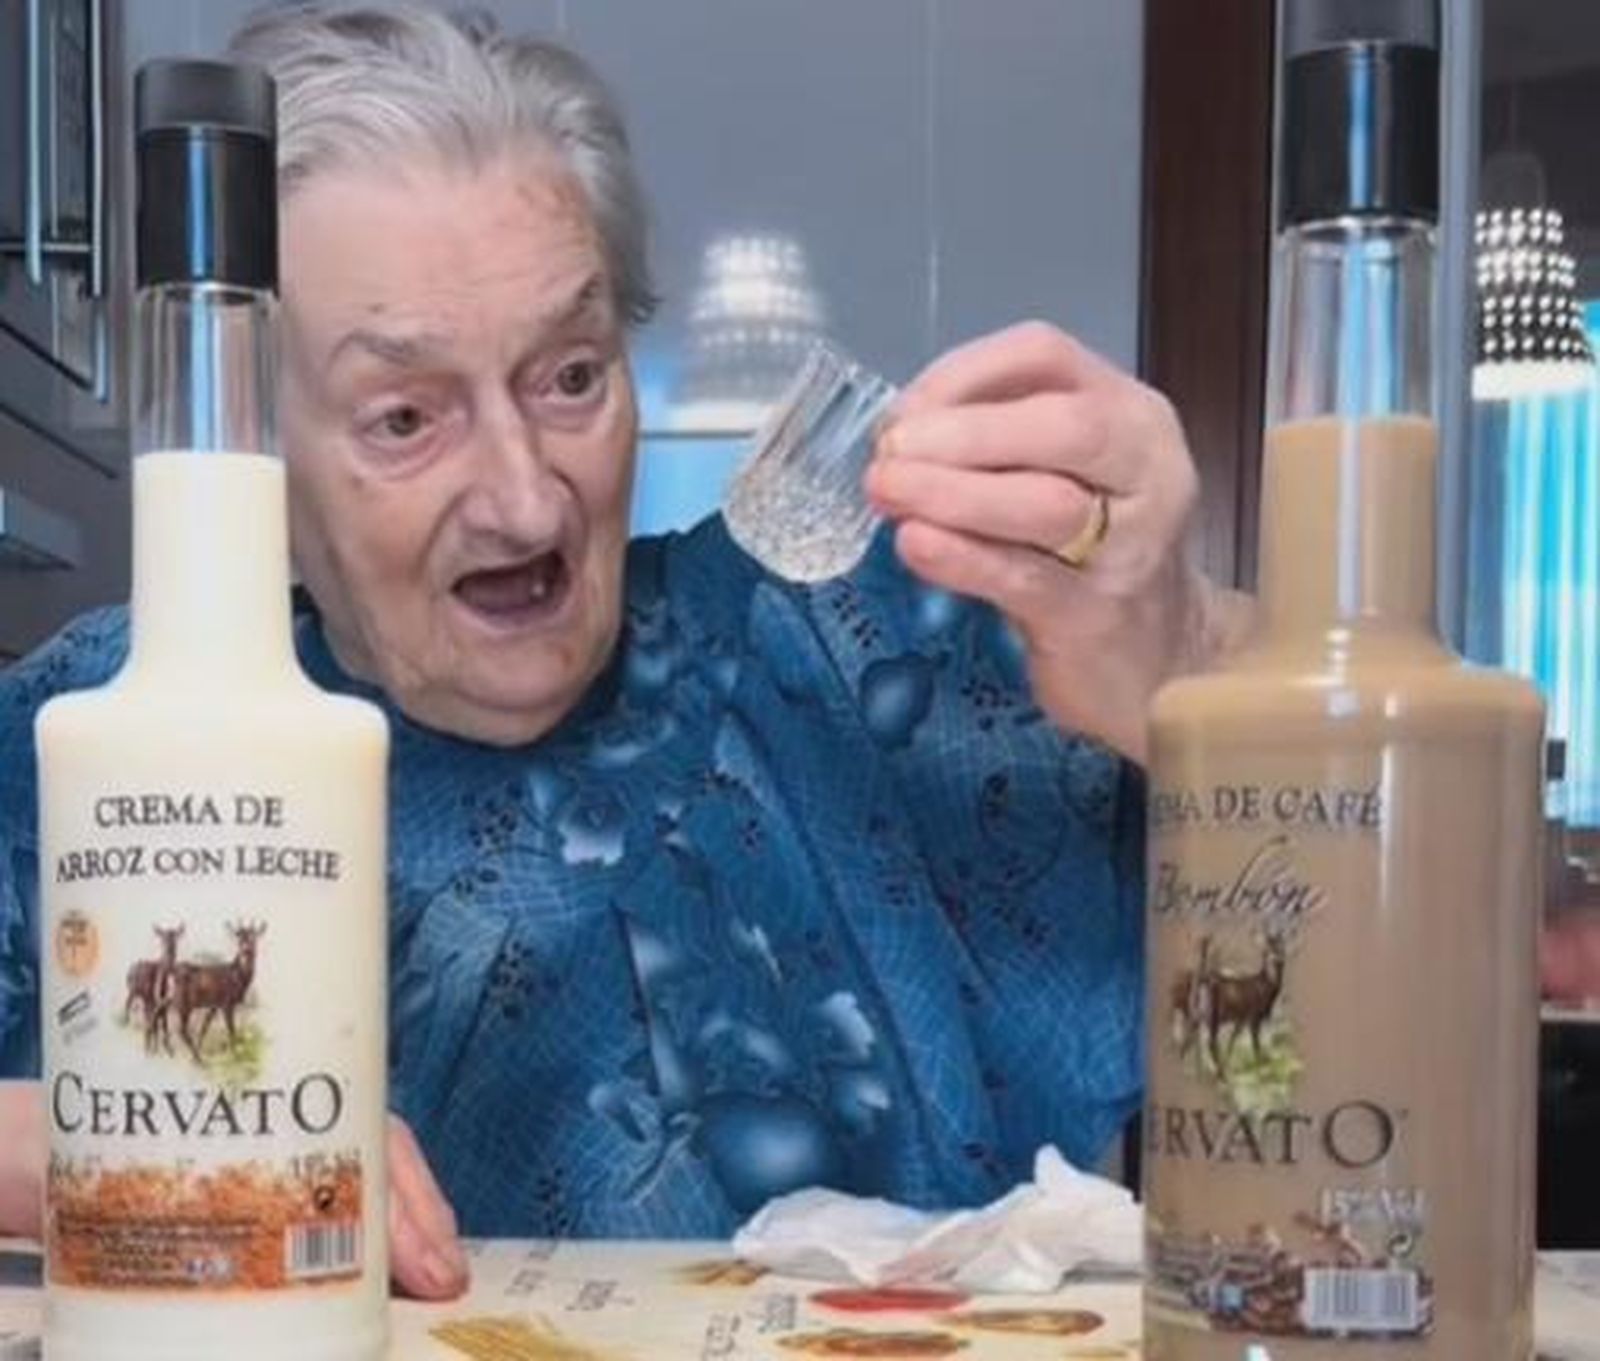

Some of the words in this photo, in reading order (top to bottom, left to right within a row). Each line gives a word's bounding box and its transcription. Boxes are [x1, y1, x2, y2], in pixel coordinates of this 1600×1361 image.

[93, 795, 221, 827] CREMA
[235, 796, 284, 826] DE
[1213, 785, 1260, 821] DE
[1273, 783, 1382, 828] CAFÉ
[56, 847, 145, 884] ARROZ
[153, 850, 224, 877] CON
[236, 847, 341, 882] LECHE
[52, 1070, 343, 1135] CERVATO
